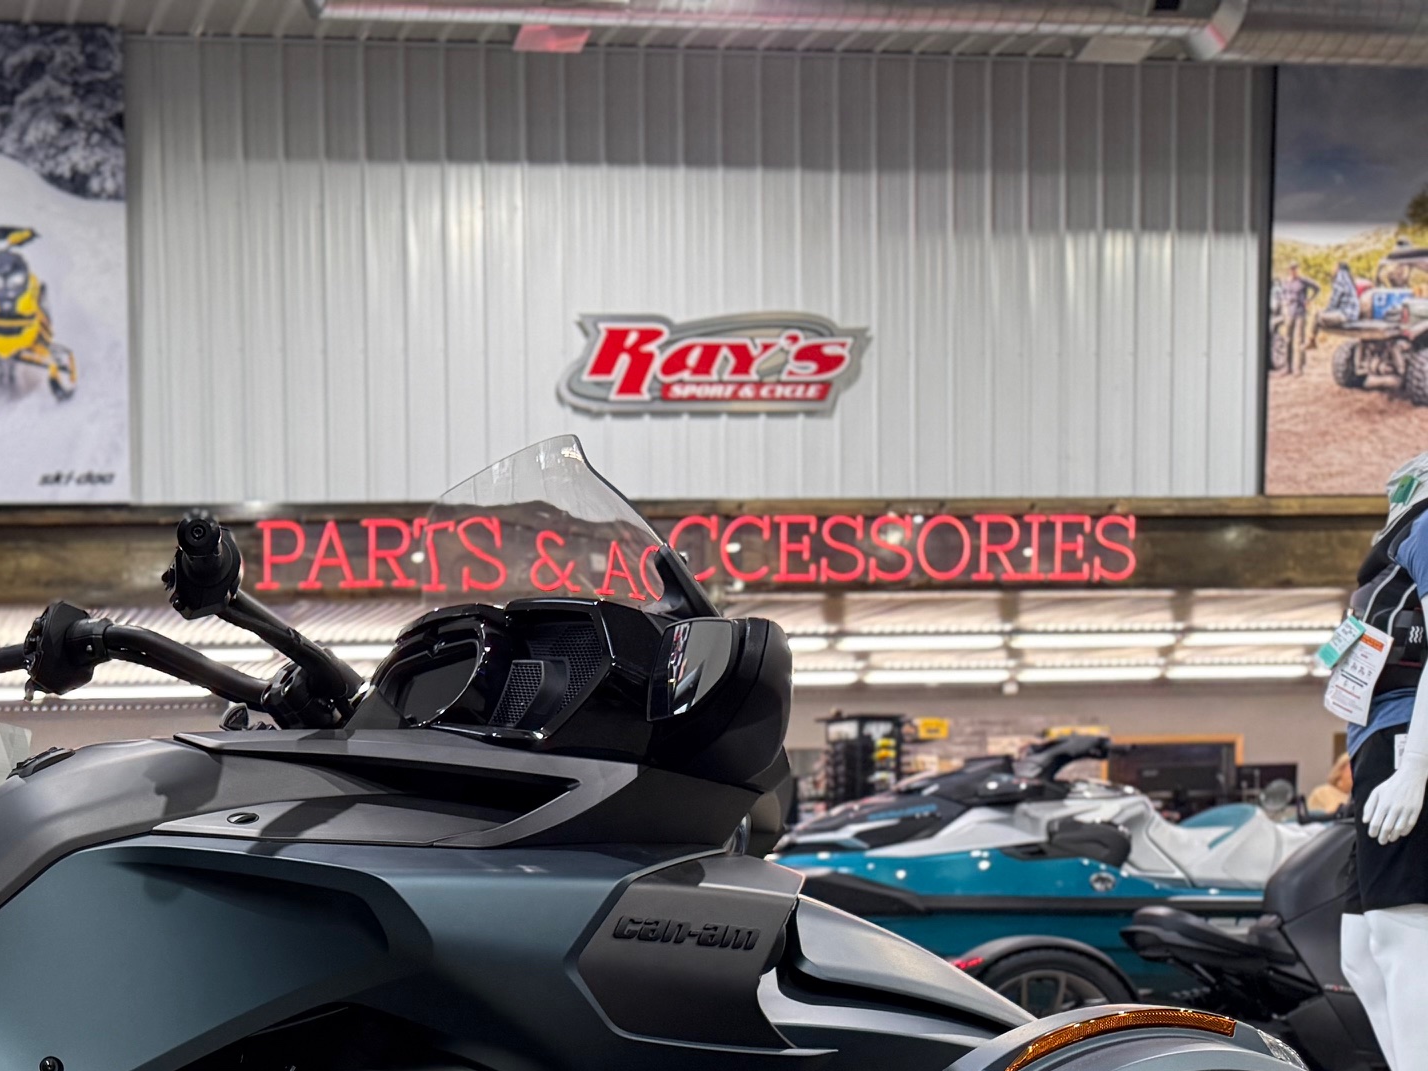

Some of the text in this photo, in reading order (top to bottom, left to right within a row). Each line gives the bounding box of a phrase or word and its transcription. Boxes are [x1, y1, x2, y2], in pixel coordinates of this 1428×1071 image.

[668, 384, 822, 399] SPORT & CYCLE
[255, 515, 507, 592] PARTS
[528, 529, 581, 593] &
[612, 914, 761, 951] can-am
